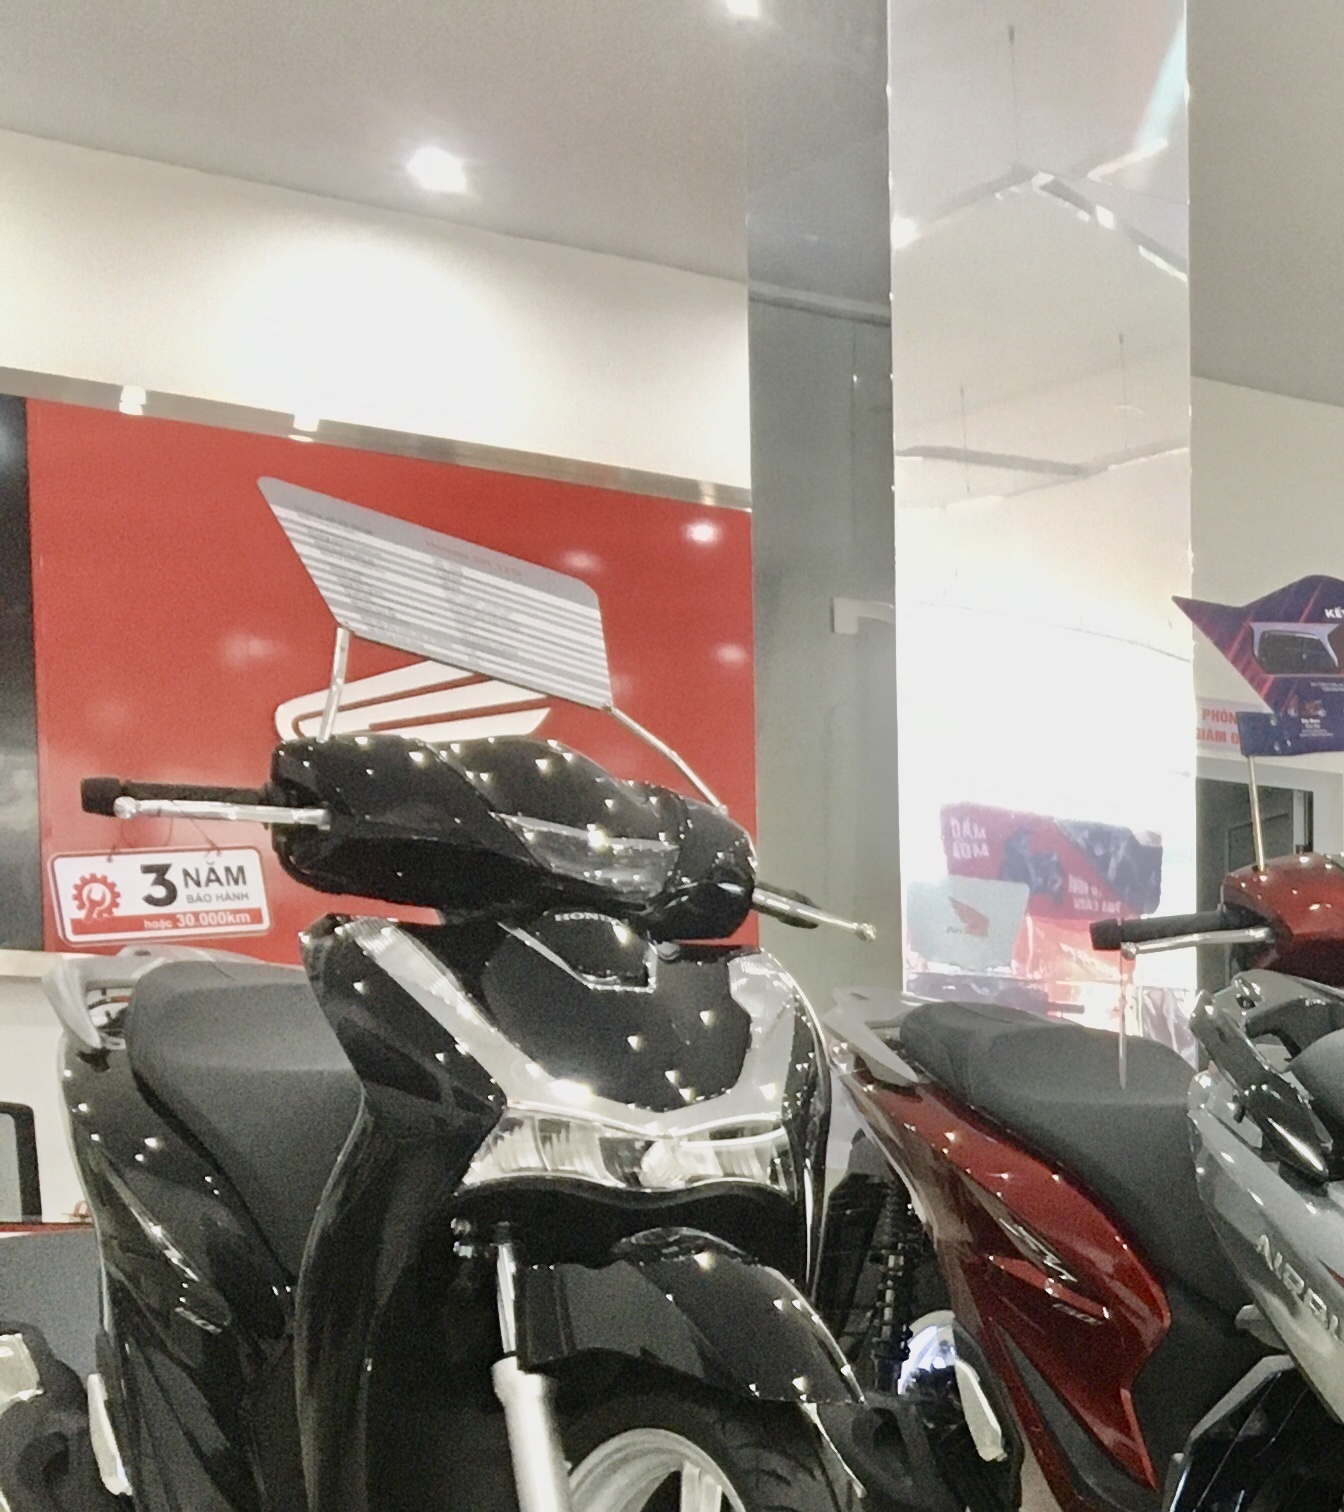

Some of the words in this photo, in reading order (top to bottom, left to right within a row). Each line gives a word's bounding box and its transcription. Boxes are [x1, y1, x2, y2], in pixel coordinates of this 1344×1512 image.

[1202, 708, 1237, 724] PHÒN
[140, 863, 178, 907] 3
[182, 861, 247, 888] NĂM
[144, 917, 173, 930] hoặc
[176, 911, 251, 928] 30.000km
